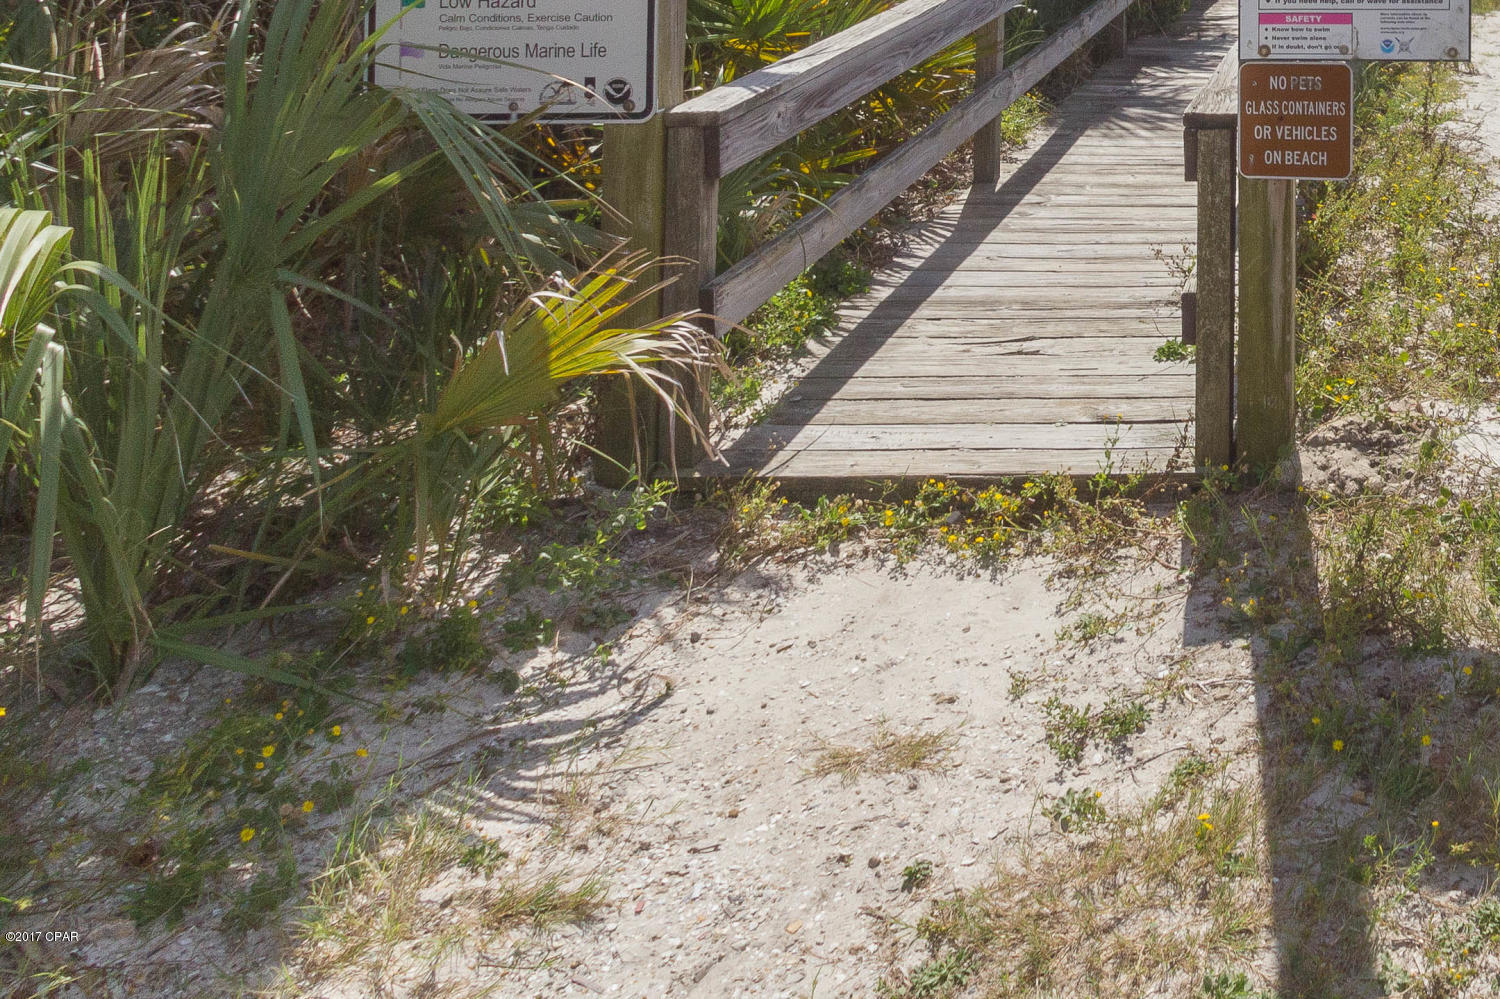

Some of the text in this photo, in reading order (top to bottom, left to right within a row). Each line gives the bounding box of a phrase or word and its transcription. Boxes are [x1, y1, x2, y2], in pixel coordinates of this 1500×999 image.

[439, 12, 613, 23] Calm Conditions, Exercise Caution
[1285, 15, 1322, 23] SAFETY
[439, 42, 607, 62] Dangerous Marine Life
[1269, 76, 1322, 90] NO PETS
[1245, 101, 1346, 116] GLASS CONTAINERS
[1254, 125, 1337, 141] OR VEHICLES
[1264, 150, 1327, 166] ON BEACH
